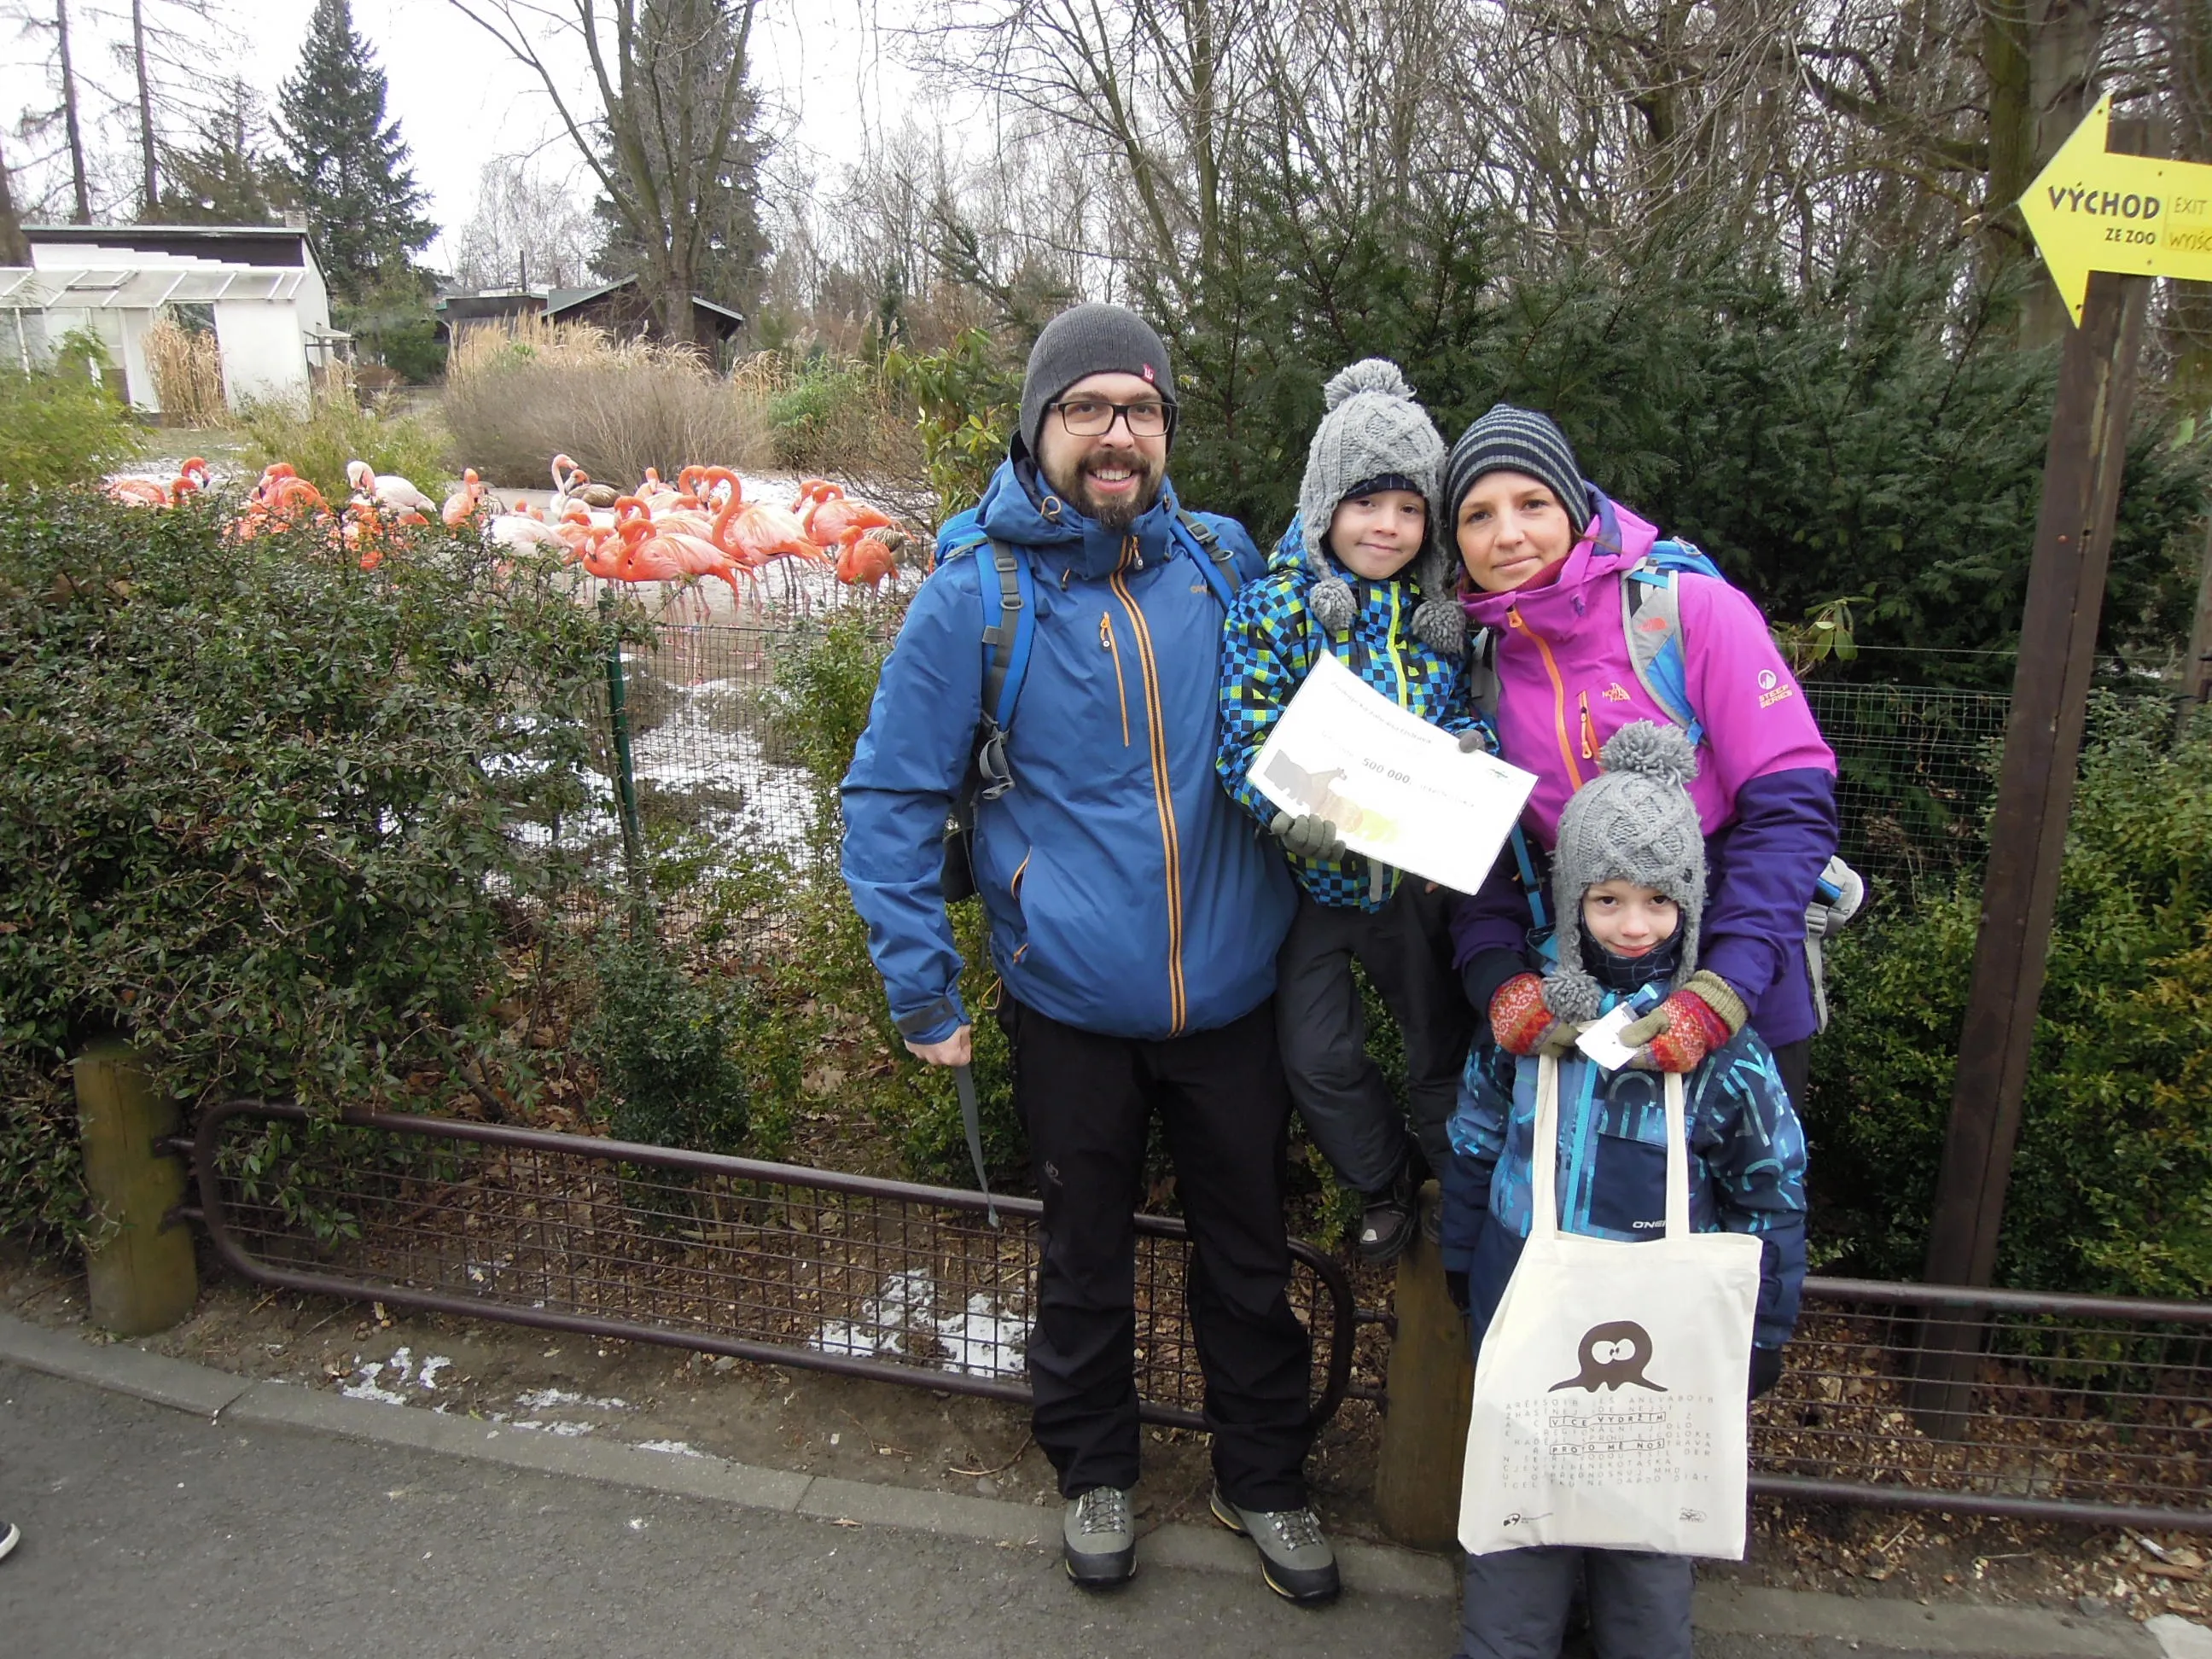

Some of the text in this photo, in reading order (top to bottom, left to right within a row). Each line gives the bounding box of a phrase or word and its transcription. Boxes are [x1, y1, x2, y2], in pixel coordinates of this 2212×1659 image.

[2047, 181, 2161, 219] VÝCHOD
[2174, 196, 2208, 215] EXIT
[2104, 227, 2157, 246] ZE ZOO
[1361, 758, 1384, 773] 500
